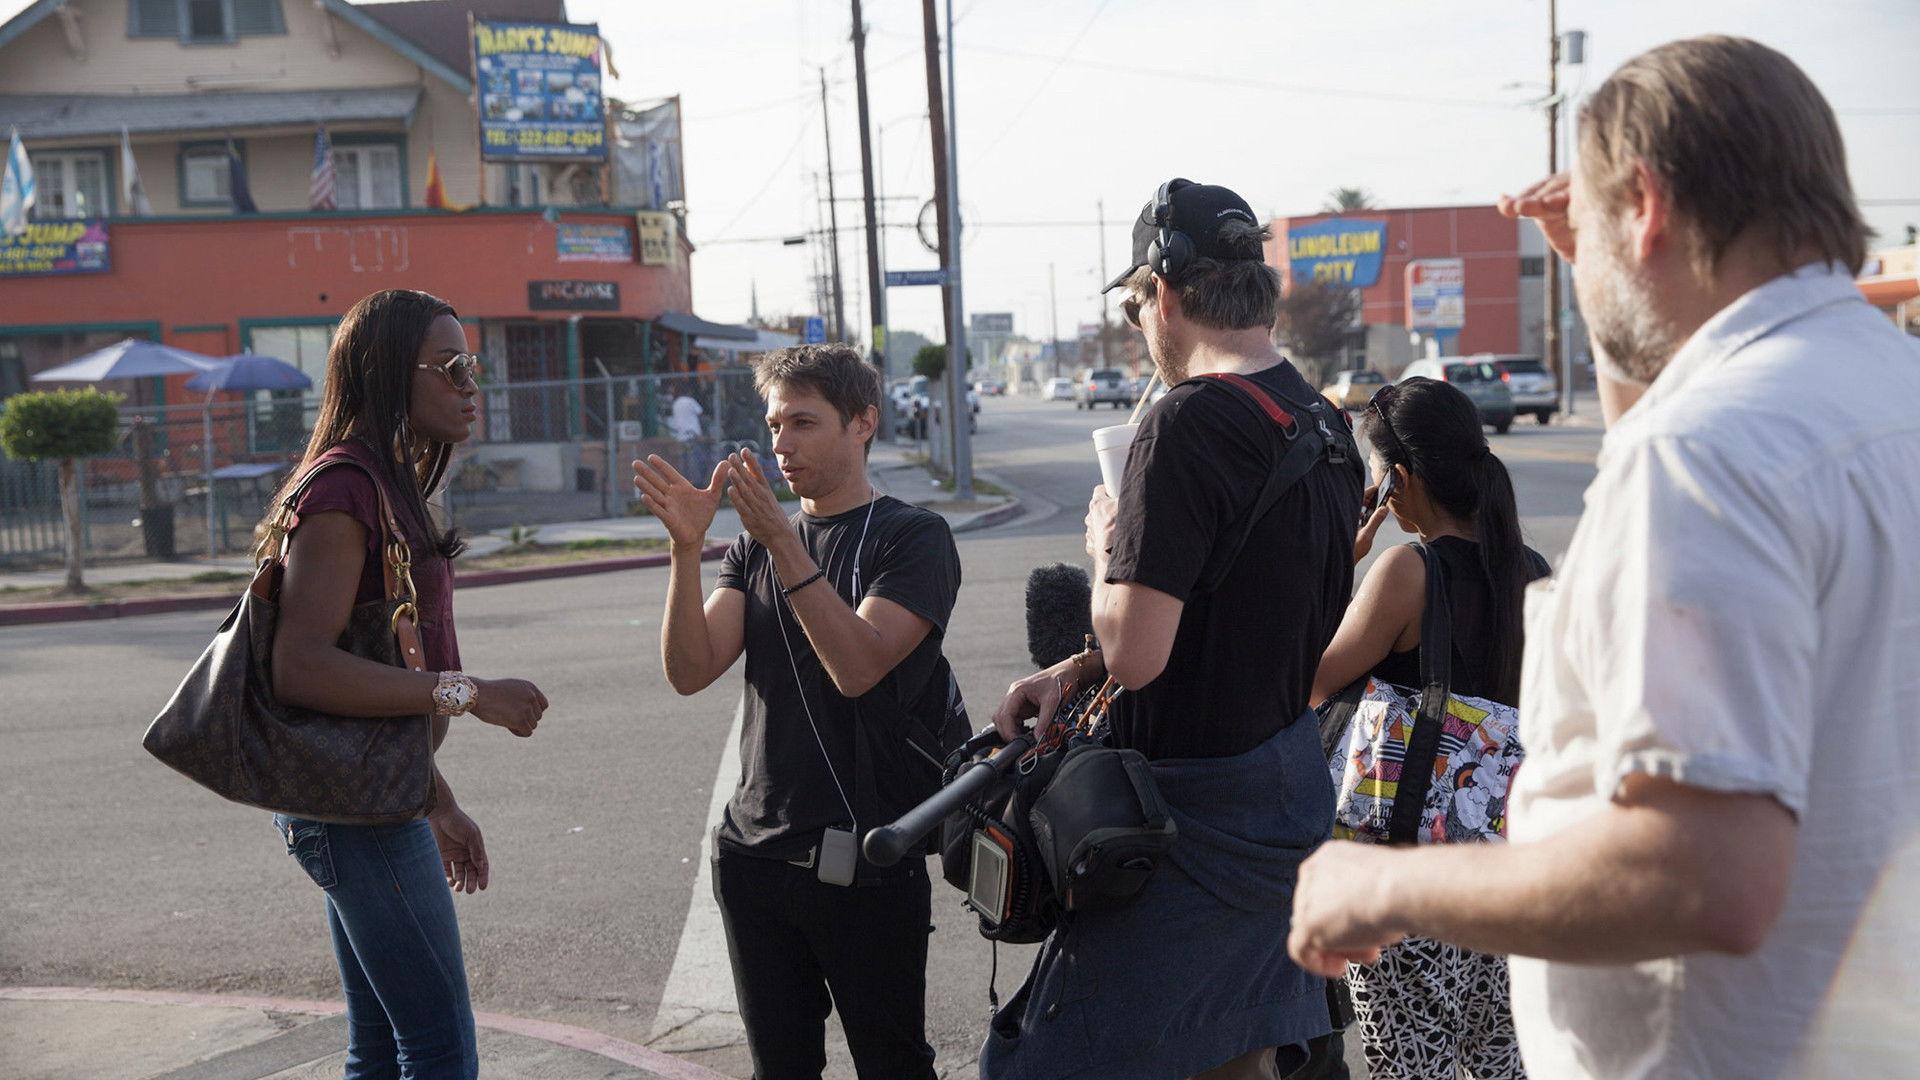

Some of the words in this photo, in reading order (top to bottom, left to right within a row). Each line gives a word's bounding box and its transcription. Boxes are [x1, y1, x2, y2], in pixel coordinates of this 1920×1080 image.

[476, 22, 546, 55] MARK'S
[546, 28, 599, 58] JUMP
[20, 223, 86, 245] JUMP
[1289, 230, 1380, 259] LINOLEUM
[1313, 261, 1355, 285] CITY
